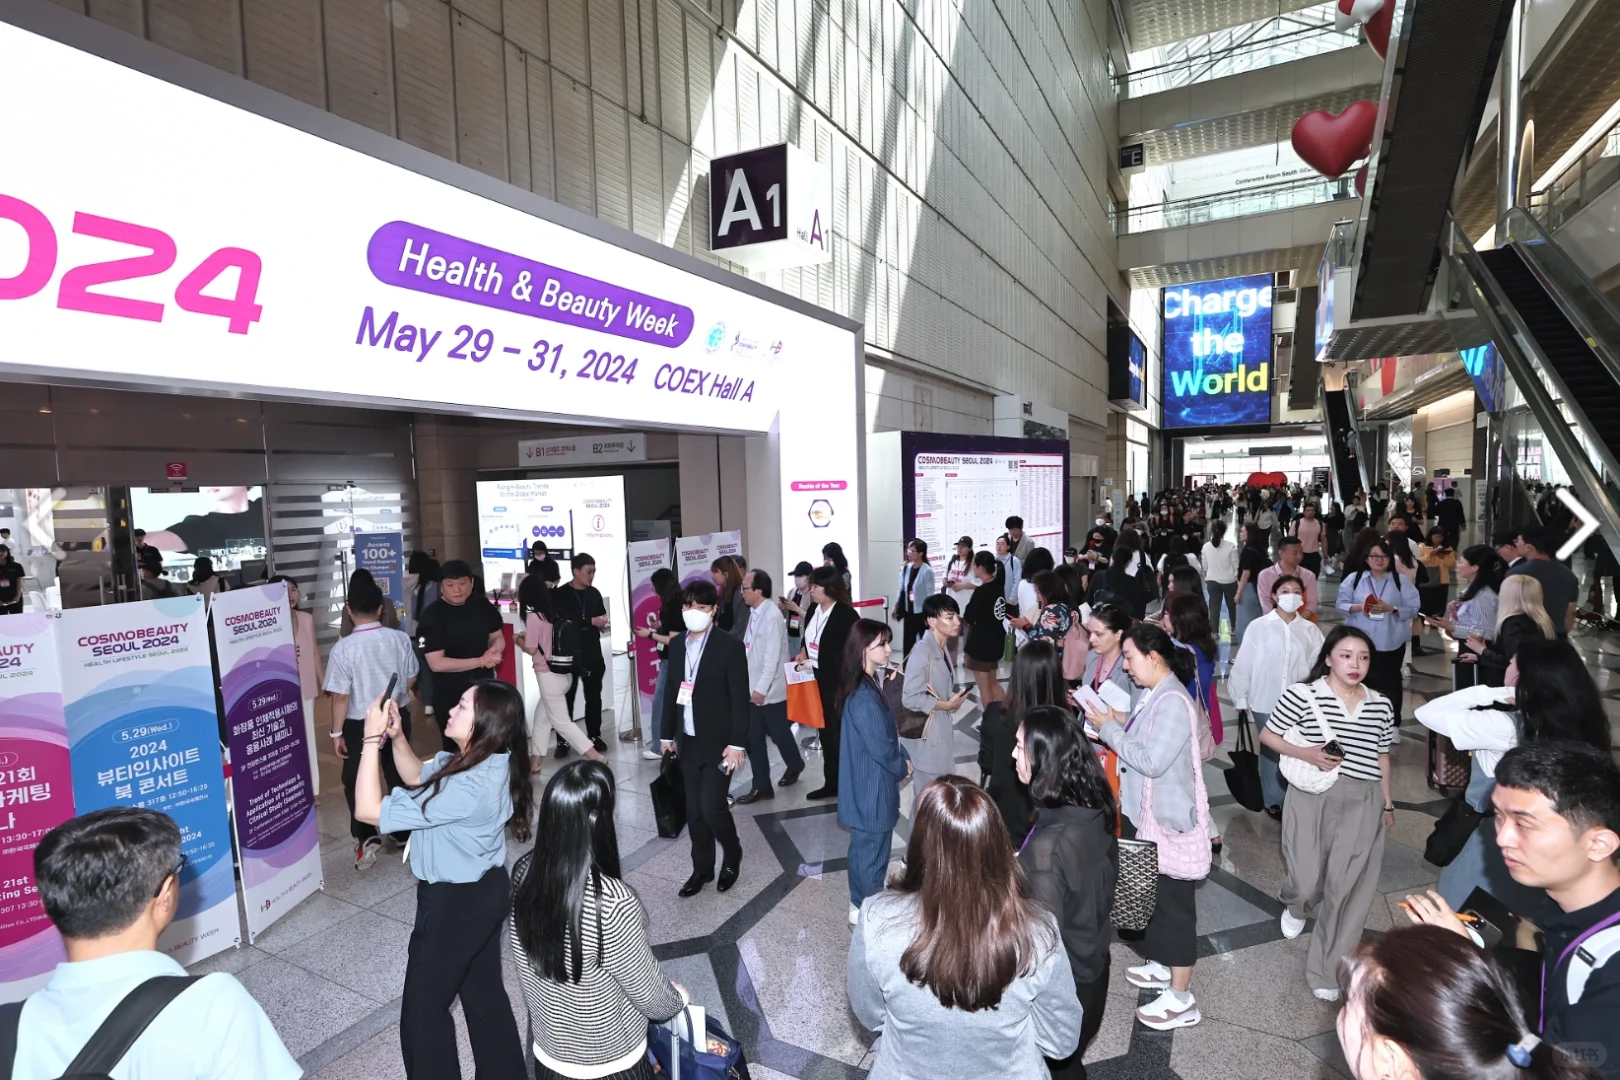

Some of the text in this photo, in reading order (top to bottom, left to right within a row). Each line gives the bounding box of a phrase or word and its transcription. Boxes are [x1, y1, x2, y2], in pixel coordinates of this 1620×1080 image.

[1131, 149, 1142, 166] E
[1235, 176, 1265, 185] Conference
[1281, 169, 1298, 177] South
[717, 168, 781, 237] A1
[397, 237, 680, 338] Health & Beauty Week
[1165, 285, 1273, 318] Charge
[355, 305, 443, 363] May
[447, 324, 494, 363] 29
[527, 339, 568, 380] 31,
[576, 349, 639, 385] 2024
[1190, 327, 1245, 357] the
[653, 363, 755, 403] COEX Hall A
[1171, 362, 1268, 397] World
[592, 443, 604, 454] B2
[918, 456, 993, 465] COSMOBEAUTY SEOUL 2024
[361, 548, 397, 559] 100+
[225, 606, 281, 627] COSMOBEAUTY
[233, 617, 278, 636] SEOUL 2024
[77, 622, 189, 648] COSMOBEAUTY
[92, 635, 180, 658] SEOUL 2024
[83, 659, 112, 669] HEALTH
[112, 653, 148, 665] LIFESTYLE
[274, 726, 293, 743] 세미나
[130, 739, 168, 759] 2024
[97, 747, 201, 788] 뷰티인사이트
[114, 768, 189, 800] 북 콘서트
[168, 783, 208, 800] 12:50-16:20
[245, 797, 275, 818] Application
[248, 793, 264, 806] Trend
[264, 789, 270, 798] of
[248, 808, 269, 825] Clinical
[268, 802, 283, 814] Study
[181, 831, 202, 844] 2024
[3, 876, 29, 889] 21st
[173, 936, 199, 951] BEAUTY
[200, 927, 220, 940] WEEK
